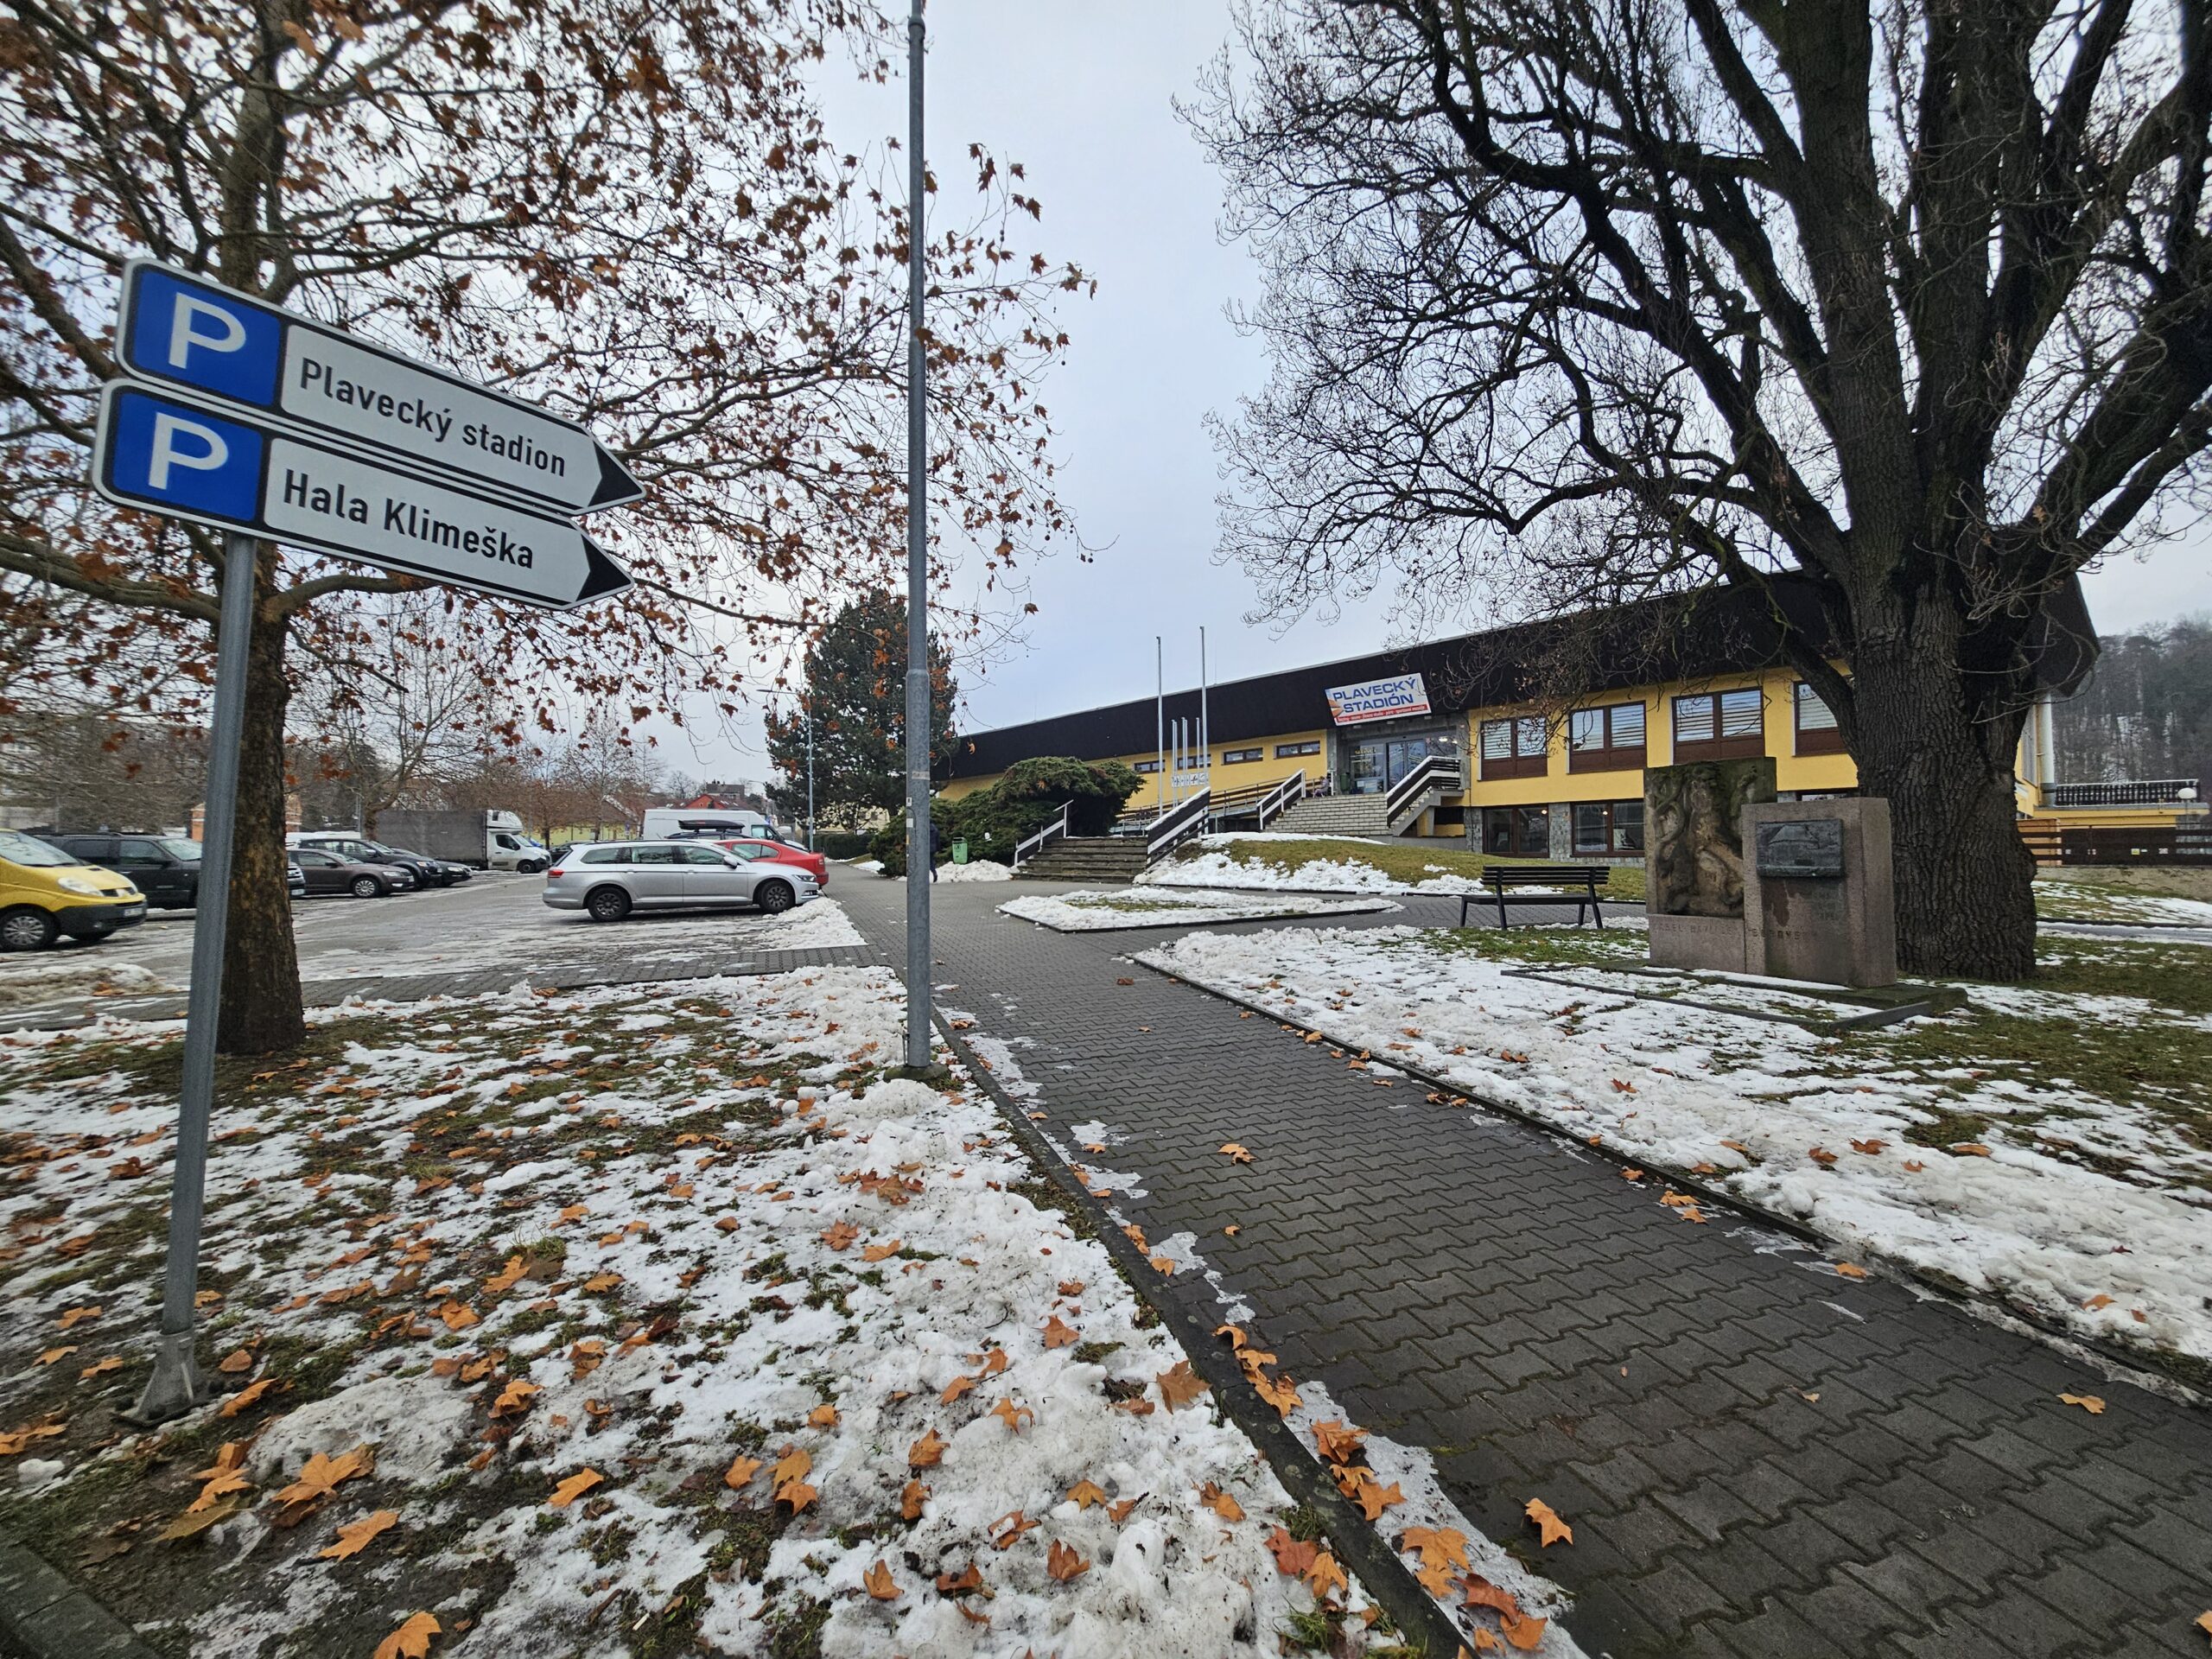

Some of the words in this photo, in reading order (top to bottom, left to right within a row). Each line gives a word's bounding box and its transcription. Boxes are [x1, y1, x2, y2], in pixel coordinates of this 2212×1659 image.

[168, 292, 247, 369] P
[301, 358, 454, 442] Plavecký
[462, 423, 567, 478] stadion
[148, 412, 229, 491] P
[283, 468, 369, 524] Hala
[384, 498, 534, 570] Klimeška
[1332, 677, 1416, 702] PLAVECKÝ
[1344, 694, 1414, 713] STADIÓN
